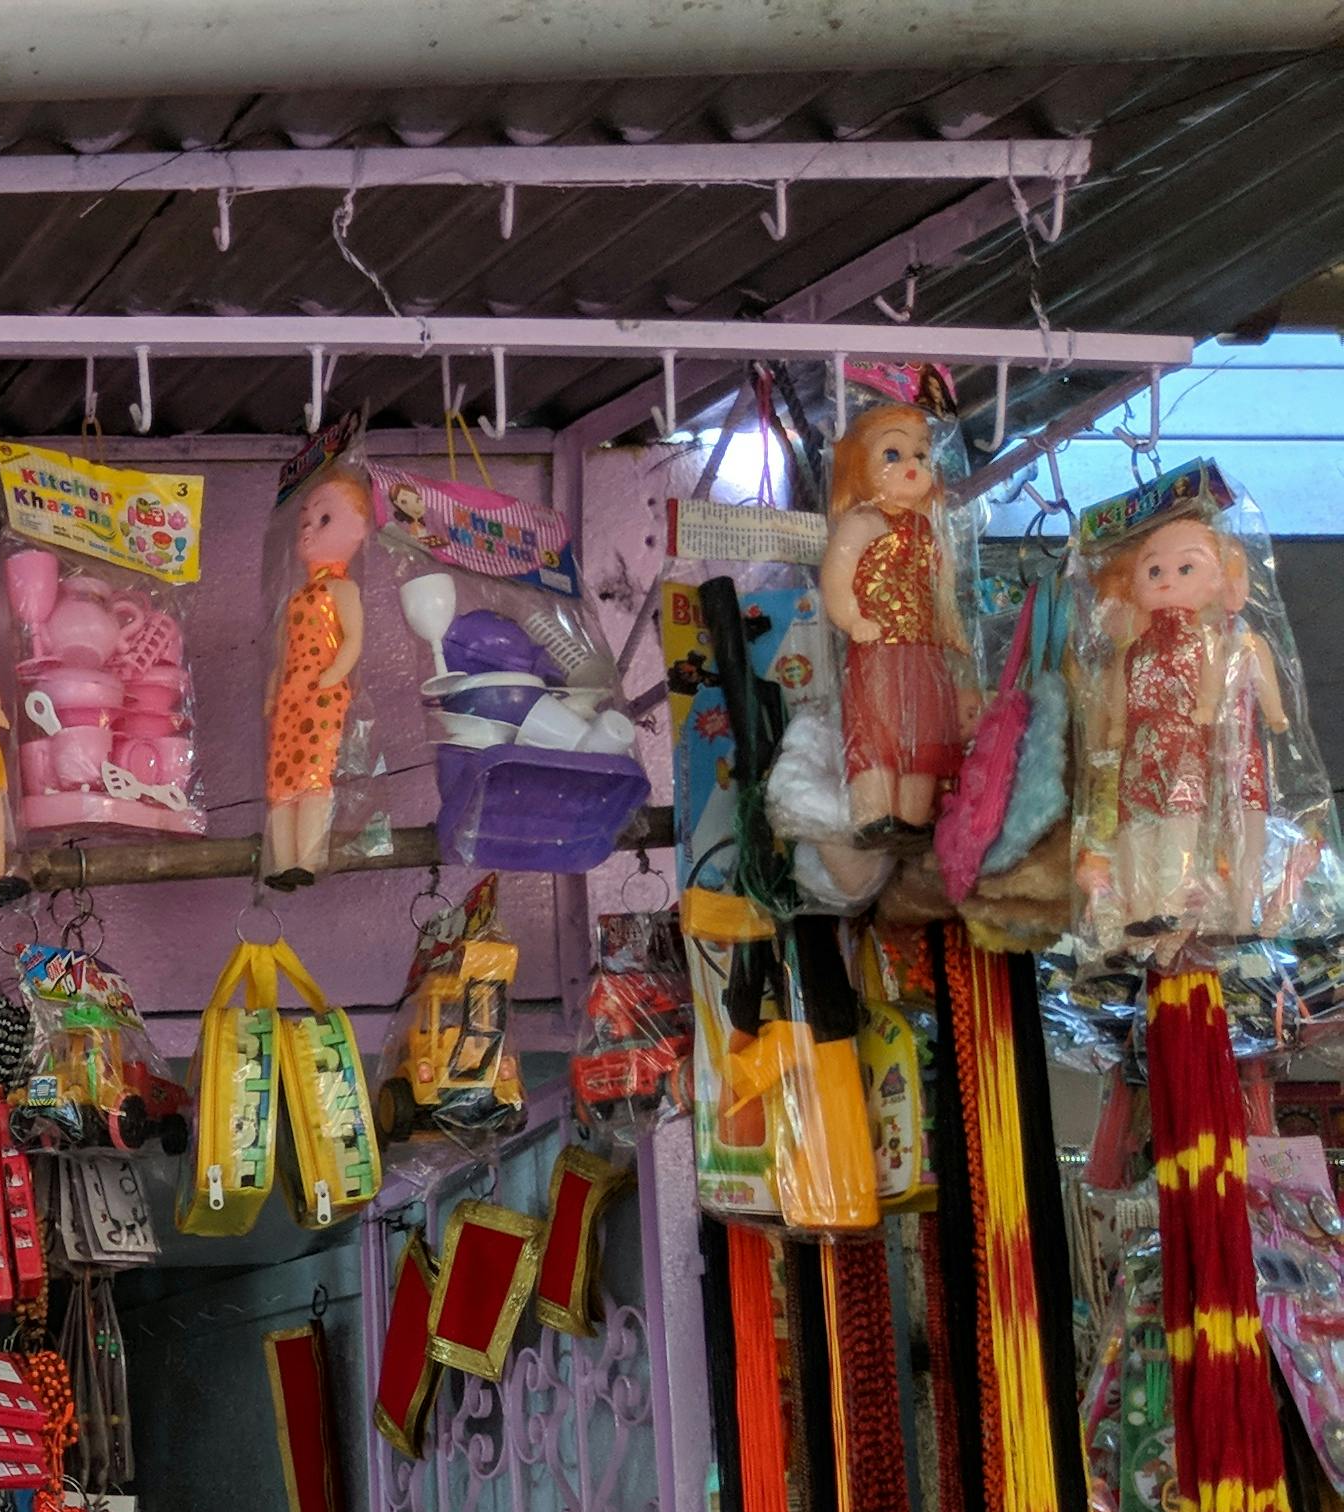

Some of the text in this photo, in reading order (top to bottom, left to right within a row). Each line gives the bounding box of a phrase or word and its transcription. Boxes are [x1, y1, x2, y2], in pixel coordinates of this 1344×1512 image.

[20, 468, 113, 505] Kitchen
[177, 482, 188, 497] 3
[13, 487, 112, 529] Khazana
